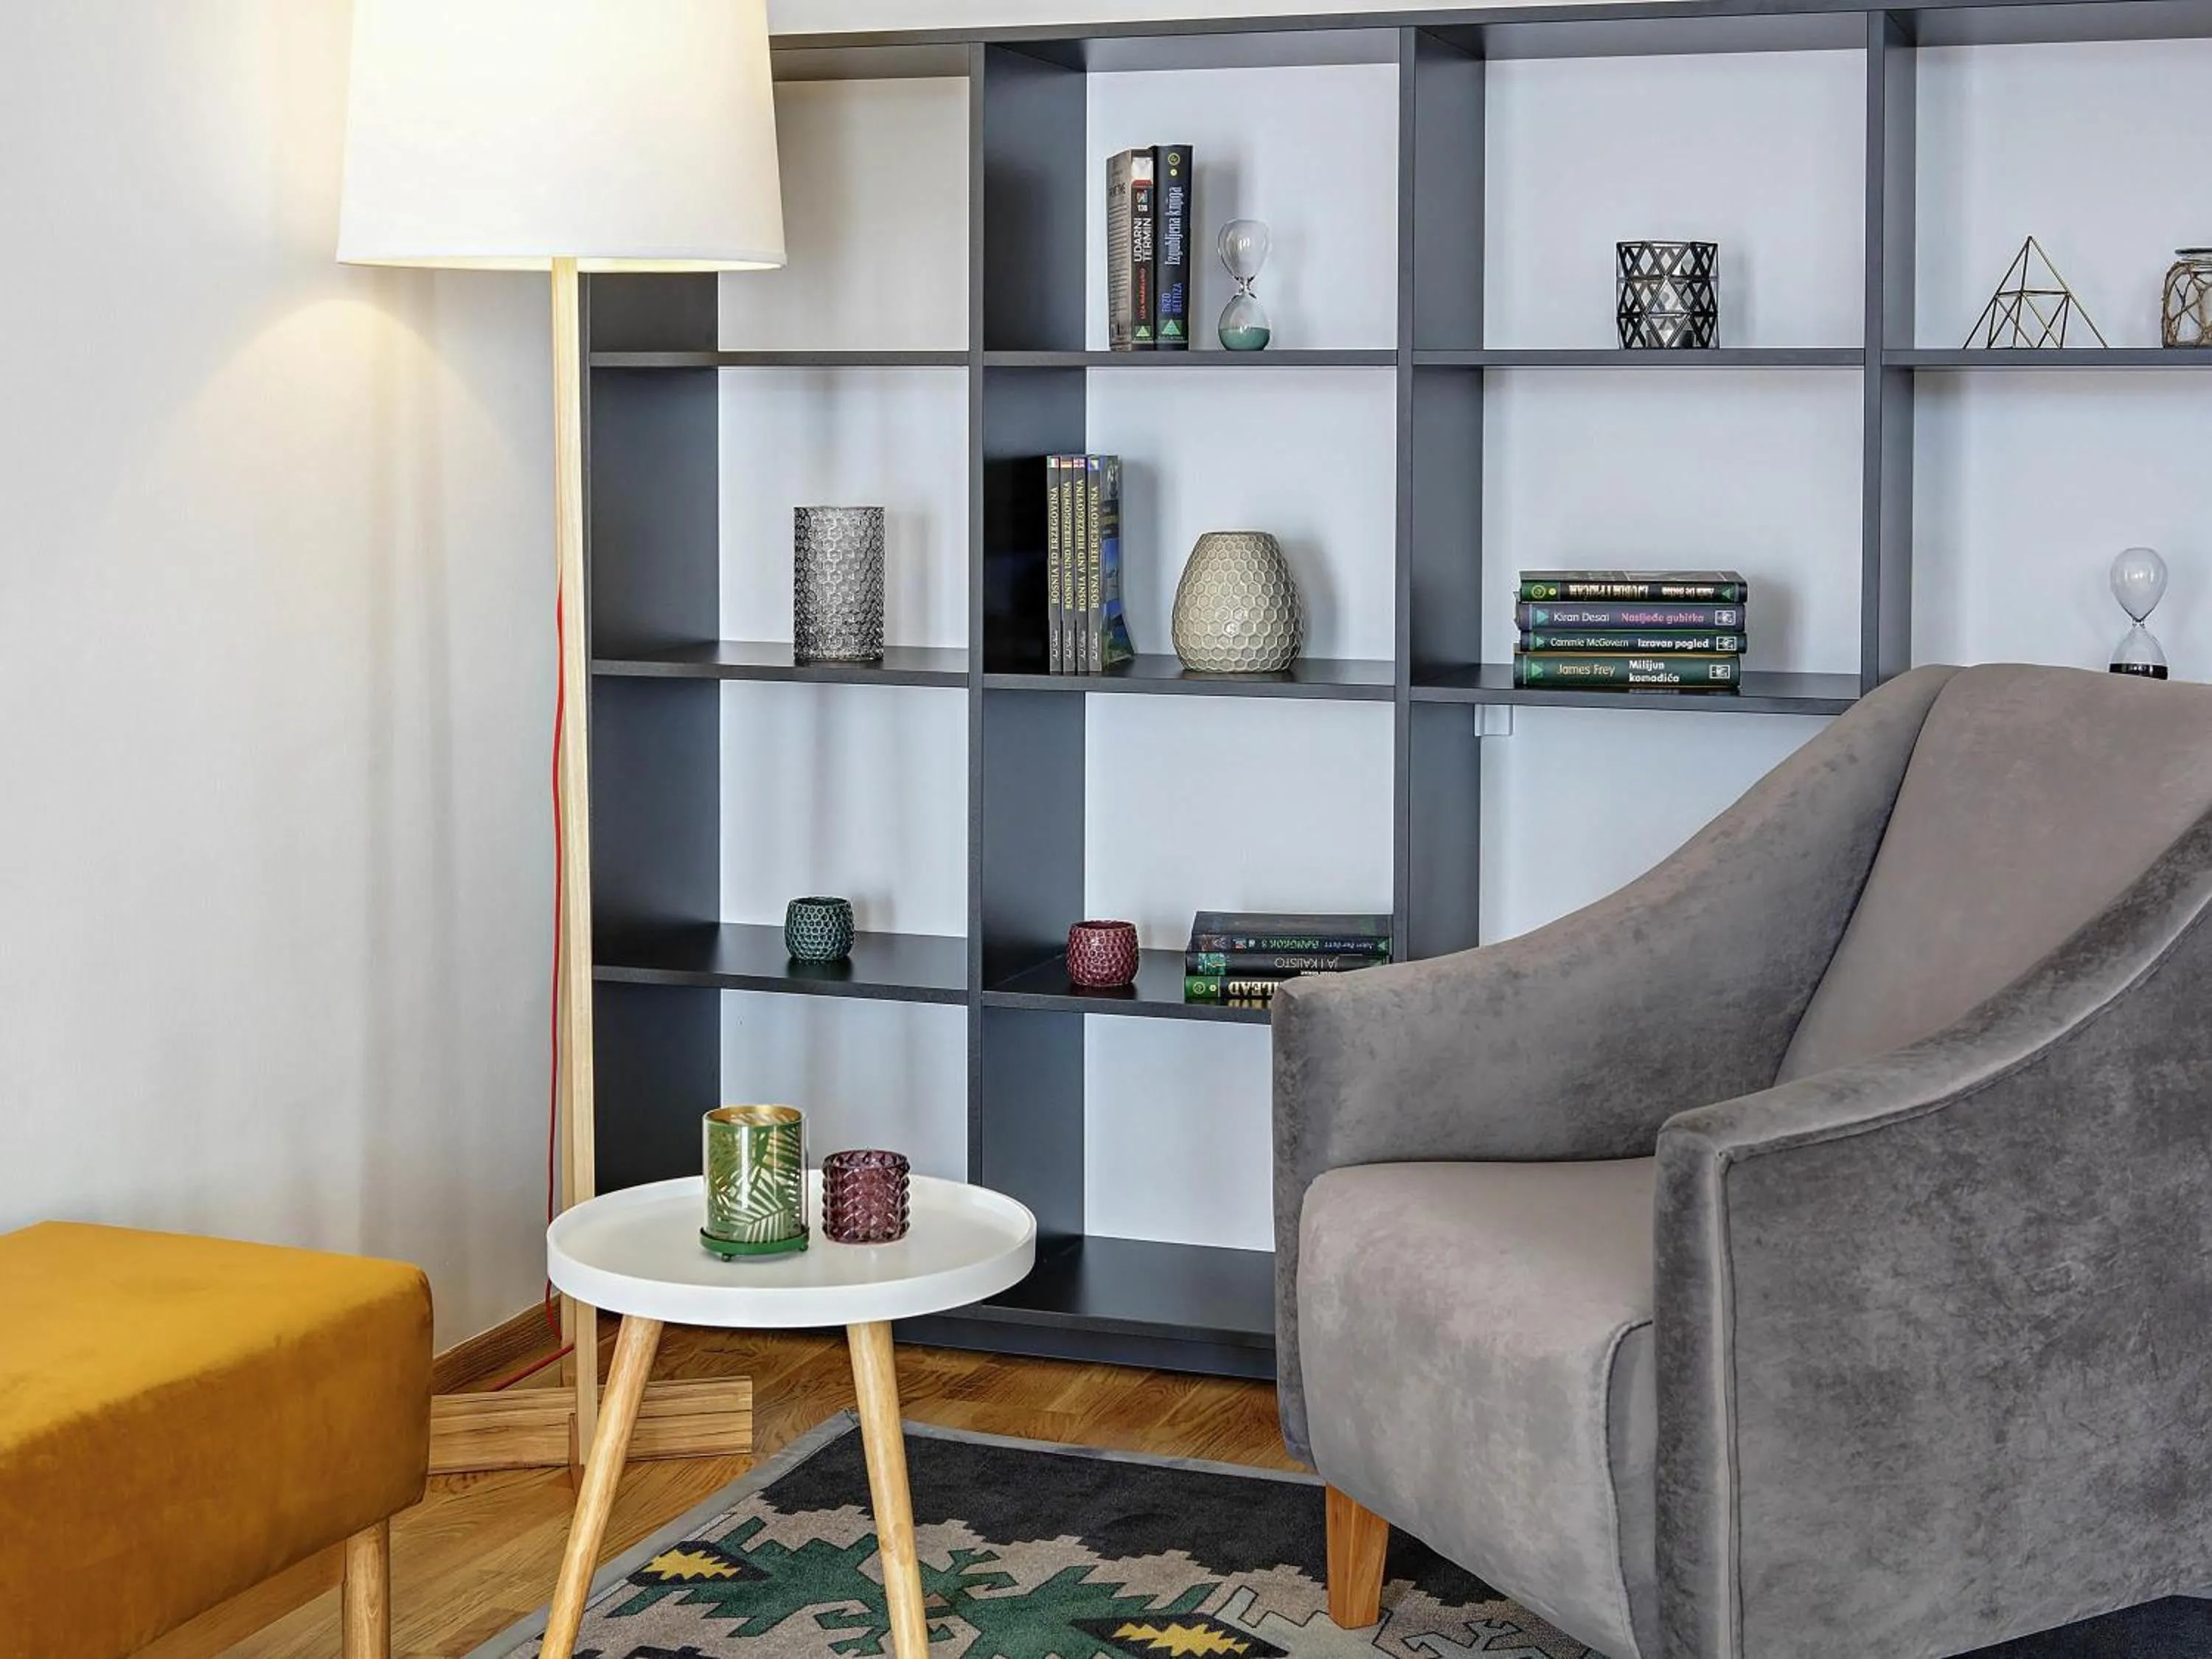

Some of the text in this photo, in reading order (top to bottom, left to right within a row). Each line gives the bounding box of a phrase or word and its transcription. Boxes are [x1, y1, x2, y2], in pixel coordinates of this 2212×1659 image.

[1133, 218, 1142, 262] UDARNI
[1143, 218, 1152, 262] TERMIN
[1161, 293, 1170, 313] ENZO
[1173, 282, 1182, 313] BETTIZA
[1090, 486, 1099, 563] HERCEGOVINA
[1049, 487, 1060, 604] BOSNIA ED ERZEGOVINA
[1076, 479, 1086, 611] BOSNIA AND HERZEGOVINA
[1064, 550, 1072, 569] UND
[1064, 571, 1073, 610] BOSNIEN
[1091, 574, 1099, 608] BOSNA
[1554, 612, 1579, 622] Kiran
[1582, 612, 1610, 622] Desai
[1667, 613, 1704, 624] gubitka
[1550, 638, 1709, 650] Cammie McGovern Izravan pogled
[1557, 664, 1615, 676] James Frey
[1629, 660, 1664, 671] Milijun
[1270, 939, 1319, 949] BANGKOK
[1326, 956, 1339, 969] JA
